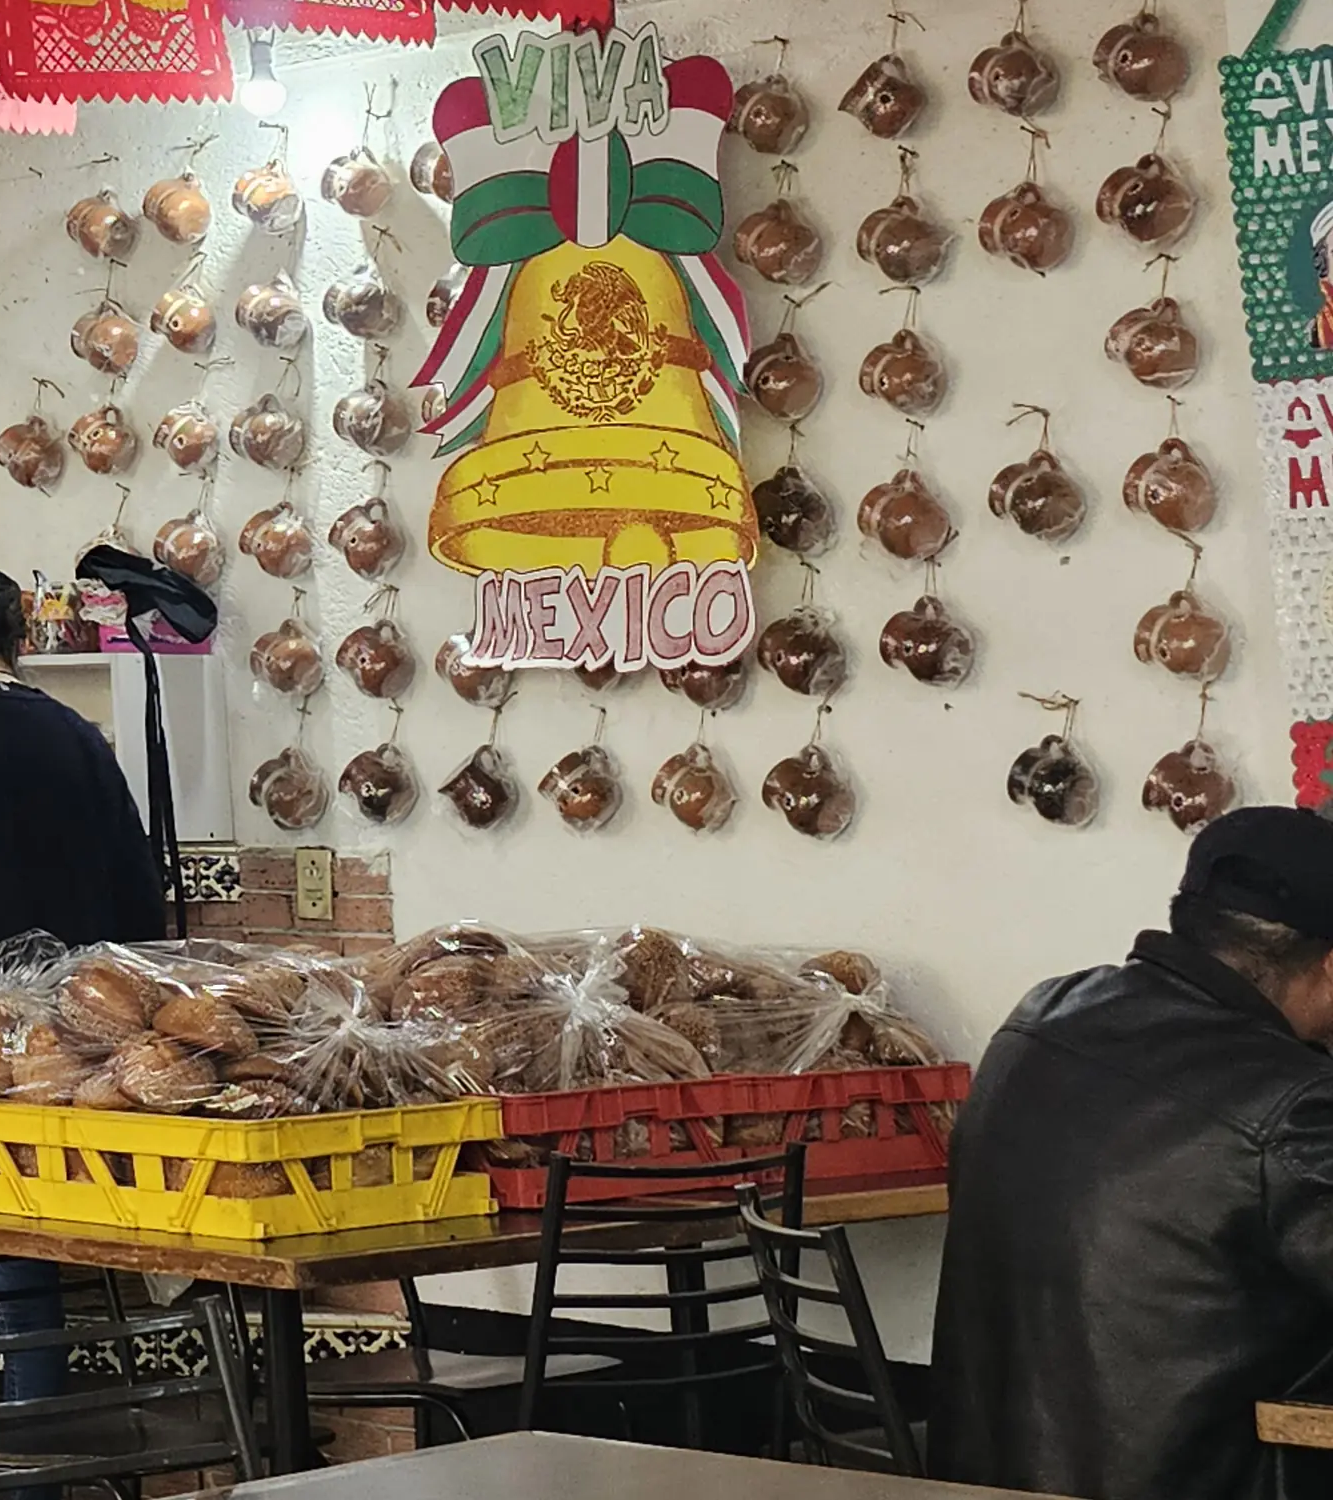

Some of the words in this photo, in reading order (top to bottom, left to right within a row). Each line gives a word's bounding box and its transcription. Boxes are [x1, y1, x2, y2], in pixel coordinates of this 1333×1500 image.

[480, 35, 665, 131] VIVA
[1253, 118, 1333, 178] ME
[472, 569, 750, 663] MEXICO
